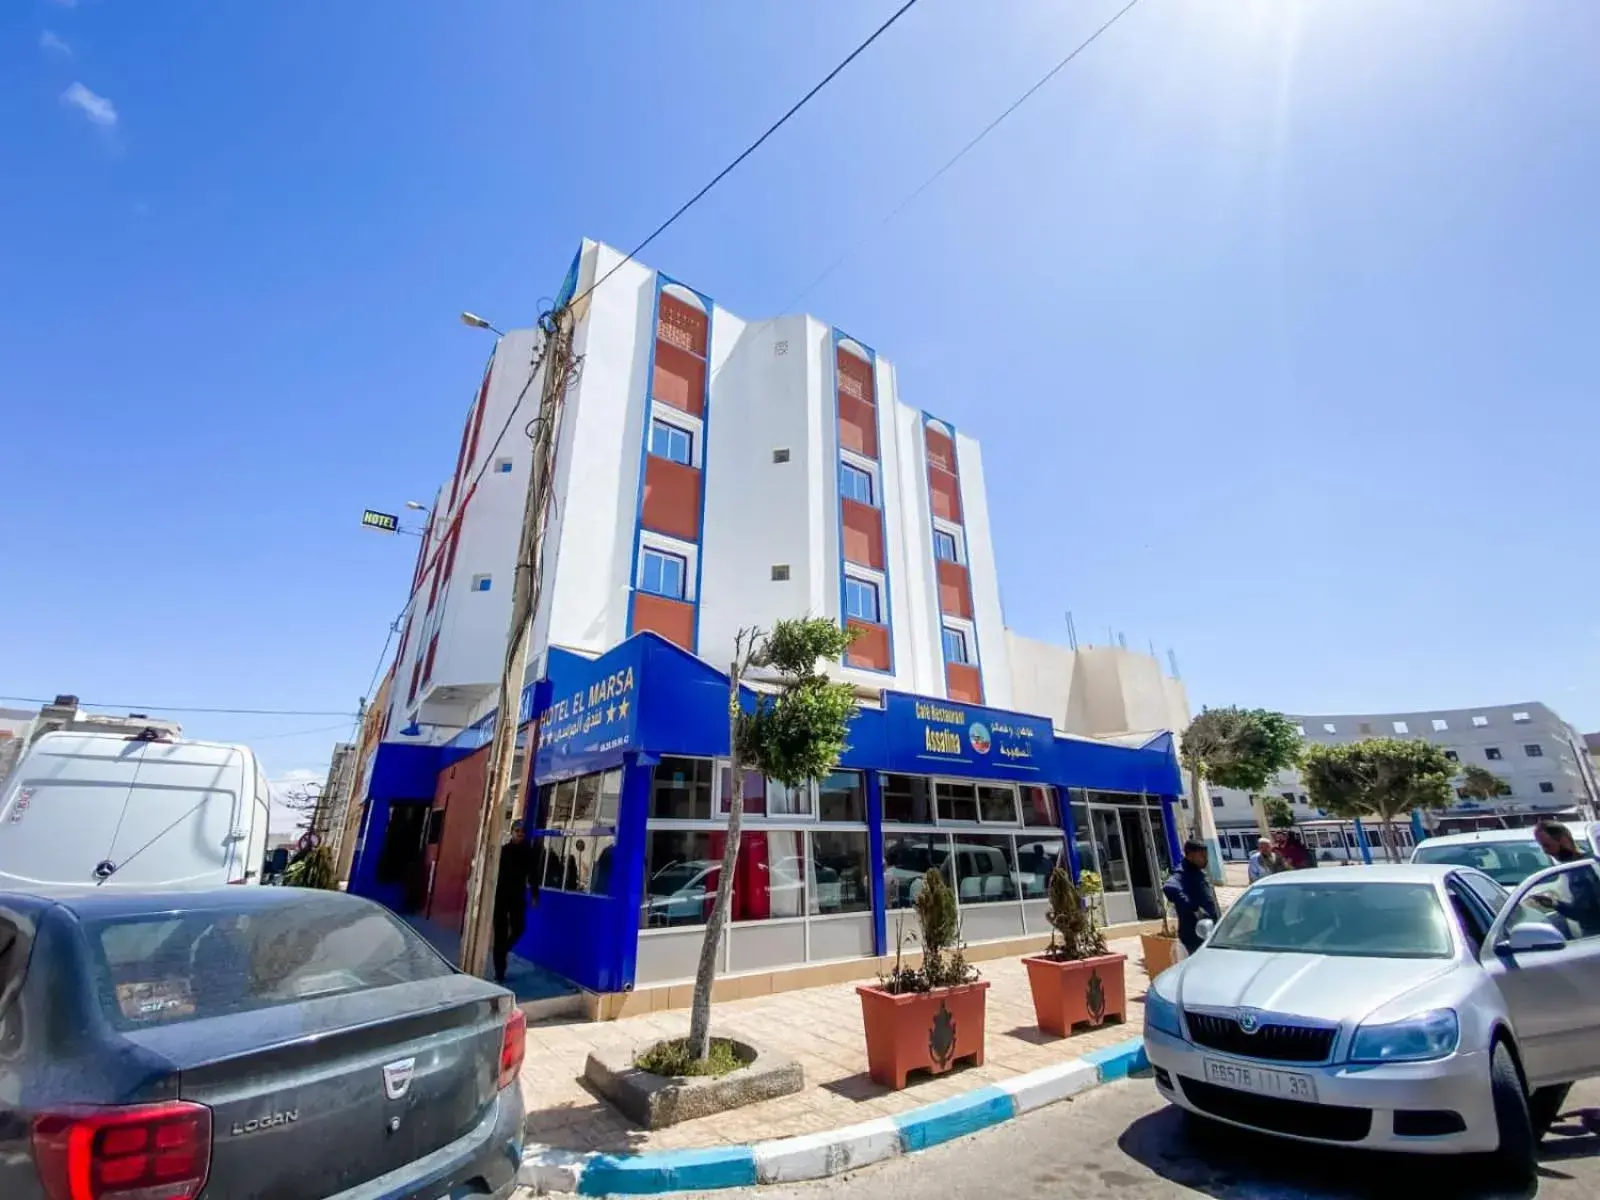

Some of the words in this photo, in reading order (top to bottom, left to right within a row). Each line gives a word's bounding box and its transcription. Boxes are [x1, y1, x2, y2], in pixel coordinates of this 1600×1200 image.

[540, 699, 569, 728] HOTEL
[572, 689, 585, 716] EL
[588, 666, 634, 708] MARSA
[231, 1108, 299, 1136] LOGAN
